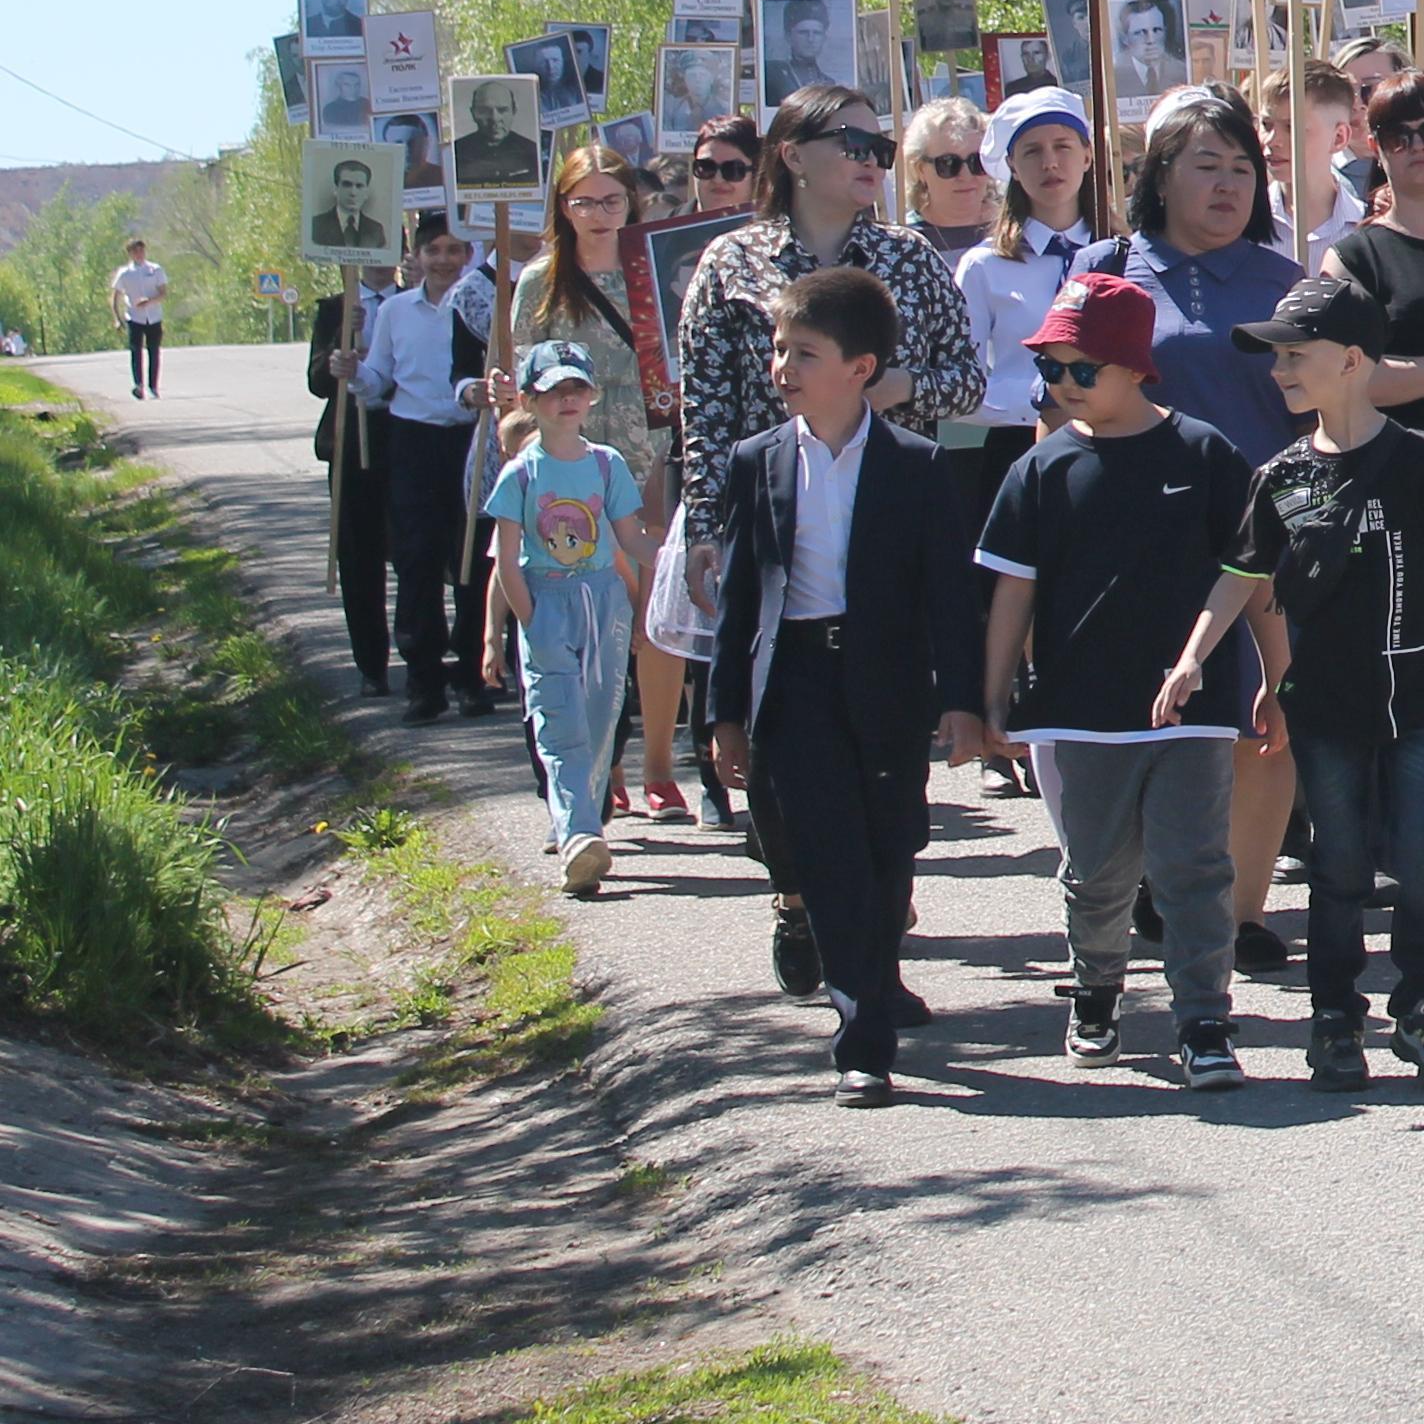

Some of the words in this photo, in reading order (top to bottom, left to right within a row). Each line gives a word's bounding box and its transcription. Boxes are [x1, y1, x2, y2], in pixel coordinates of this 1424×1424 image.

[391, 63, 416, 73] ПОЛК
[1367, 498, 1383, 509] REL
[1368, 509, 1384, 520] EVA
[1369, 520, 1385, 531] NCE
[1393, 530, 1402, 551] REAL
[1395, 553, 1404, 570] THE
[1395, 571, 1404, 588] YOU
[1395, 590, 1403, 614] SHOW
[1393, 615, 1402, 627] TO
[611, 618, 629, 655] Love
[1393, 628, 1401, 649] TIME
